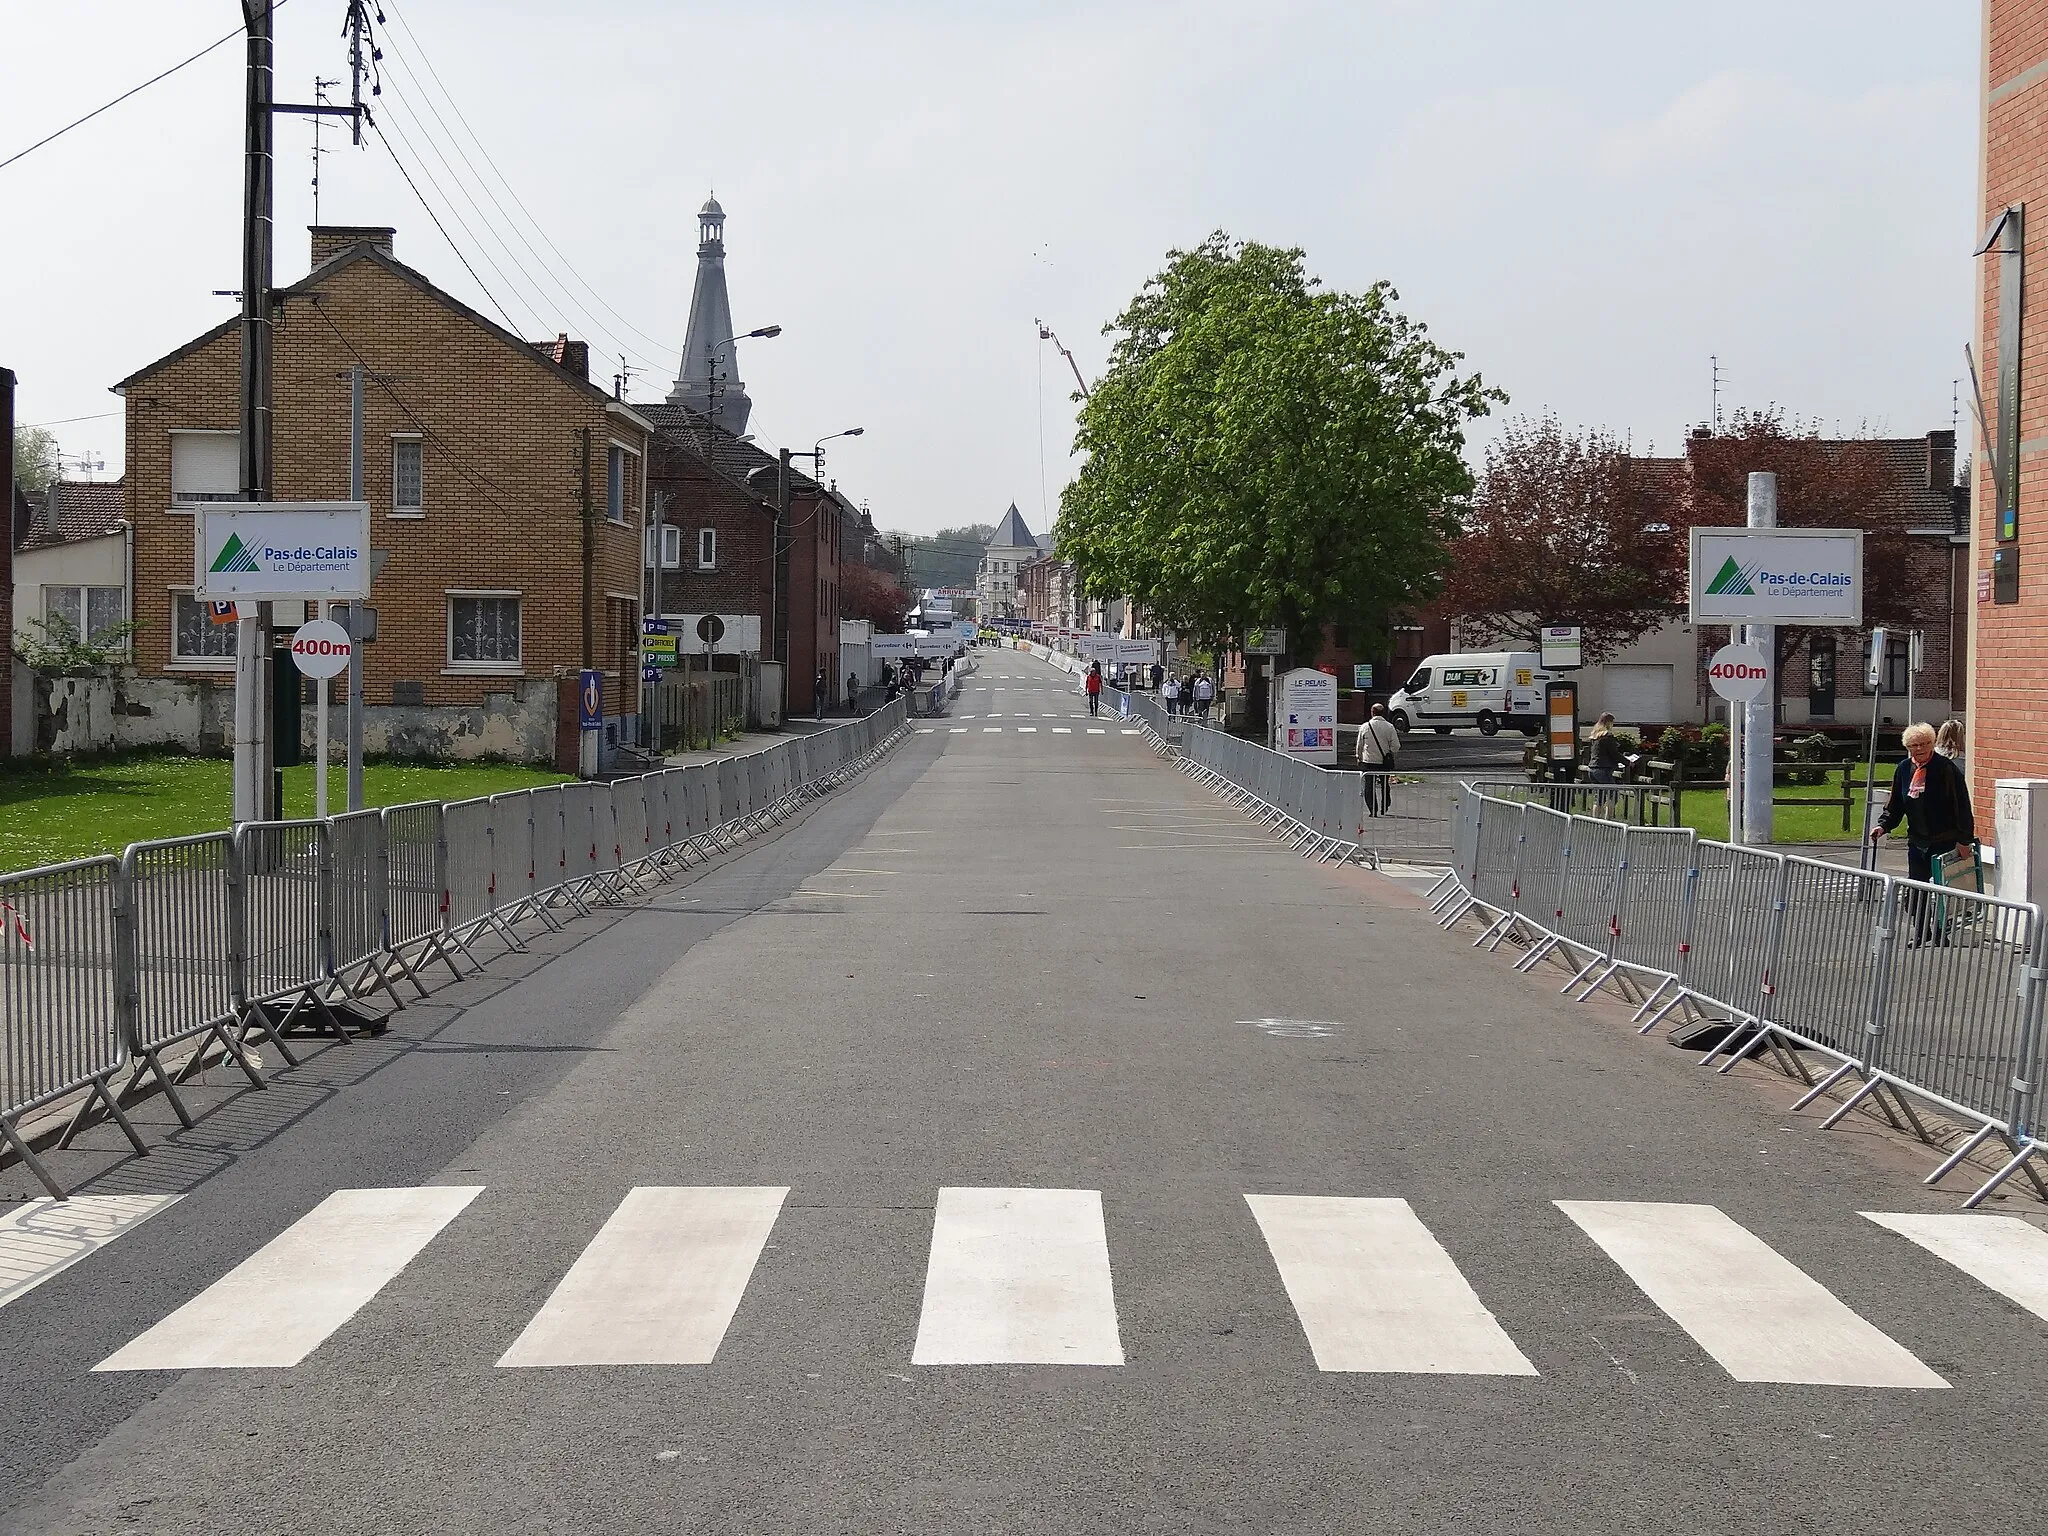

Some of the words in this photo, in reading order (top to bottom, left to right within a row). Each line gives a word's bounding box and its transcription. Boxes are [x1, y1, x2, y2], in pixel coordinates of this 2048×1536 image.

[273, 563, 285, 572] Le
[287, 562, 350, 574] Département
[1768, 587, 1780, 596] Le
[1782, 586, 1844, 598] Département
[214, 600, 228, 614] P
[648, 623, 655, 631] P
[293, 640, 350, 656] 400m
[647, 654, 655, 663] P
[657, 654, 676, 662] PRESSE
[647, 669, 654, 678] P
[1709, 663, 1767, 679] 400m
